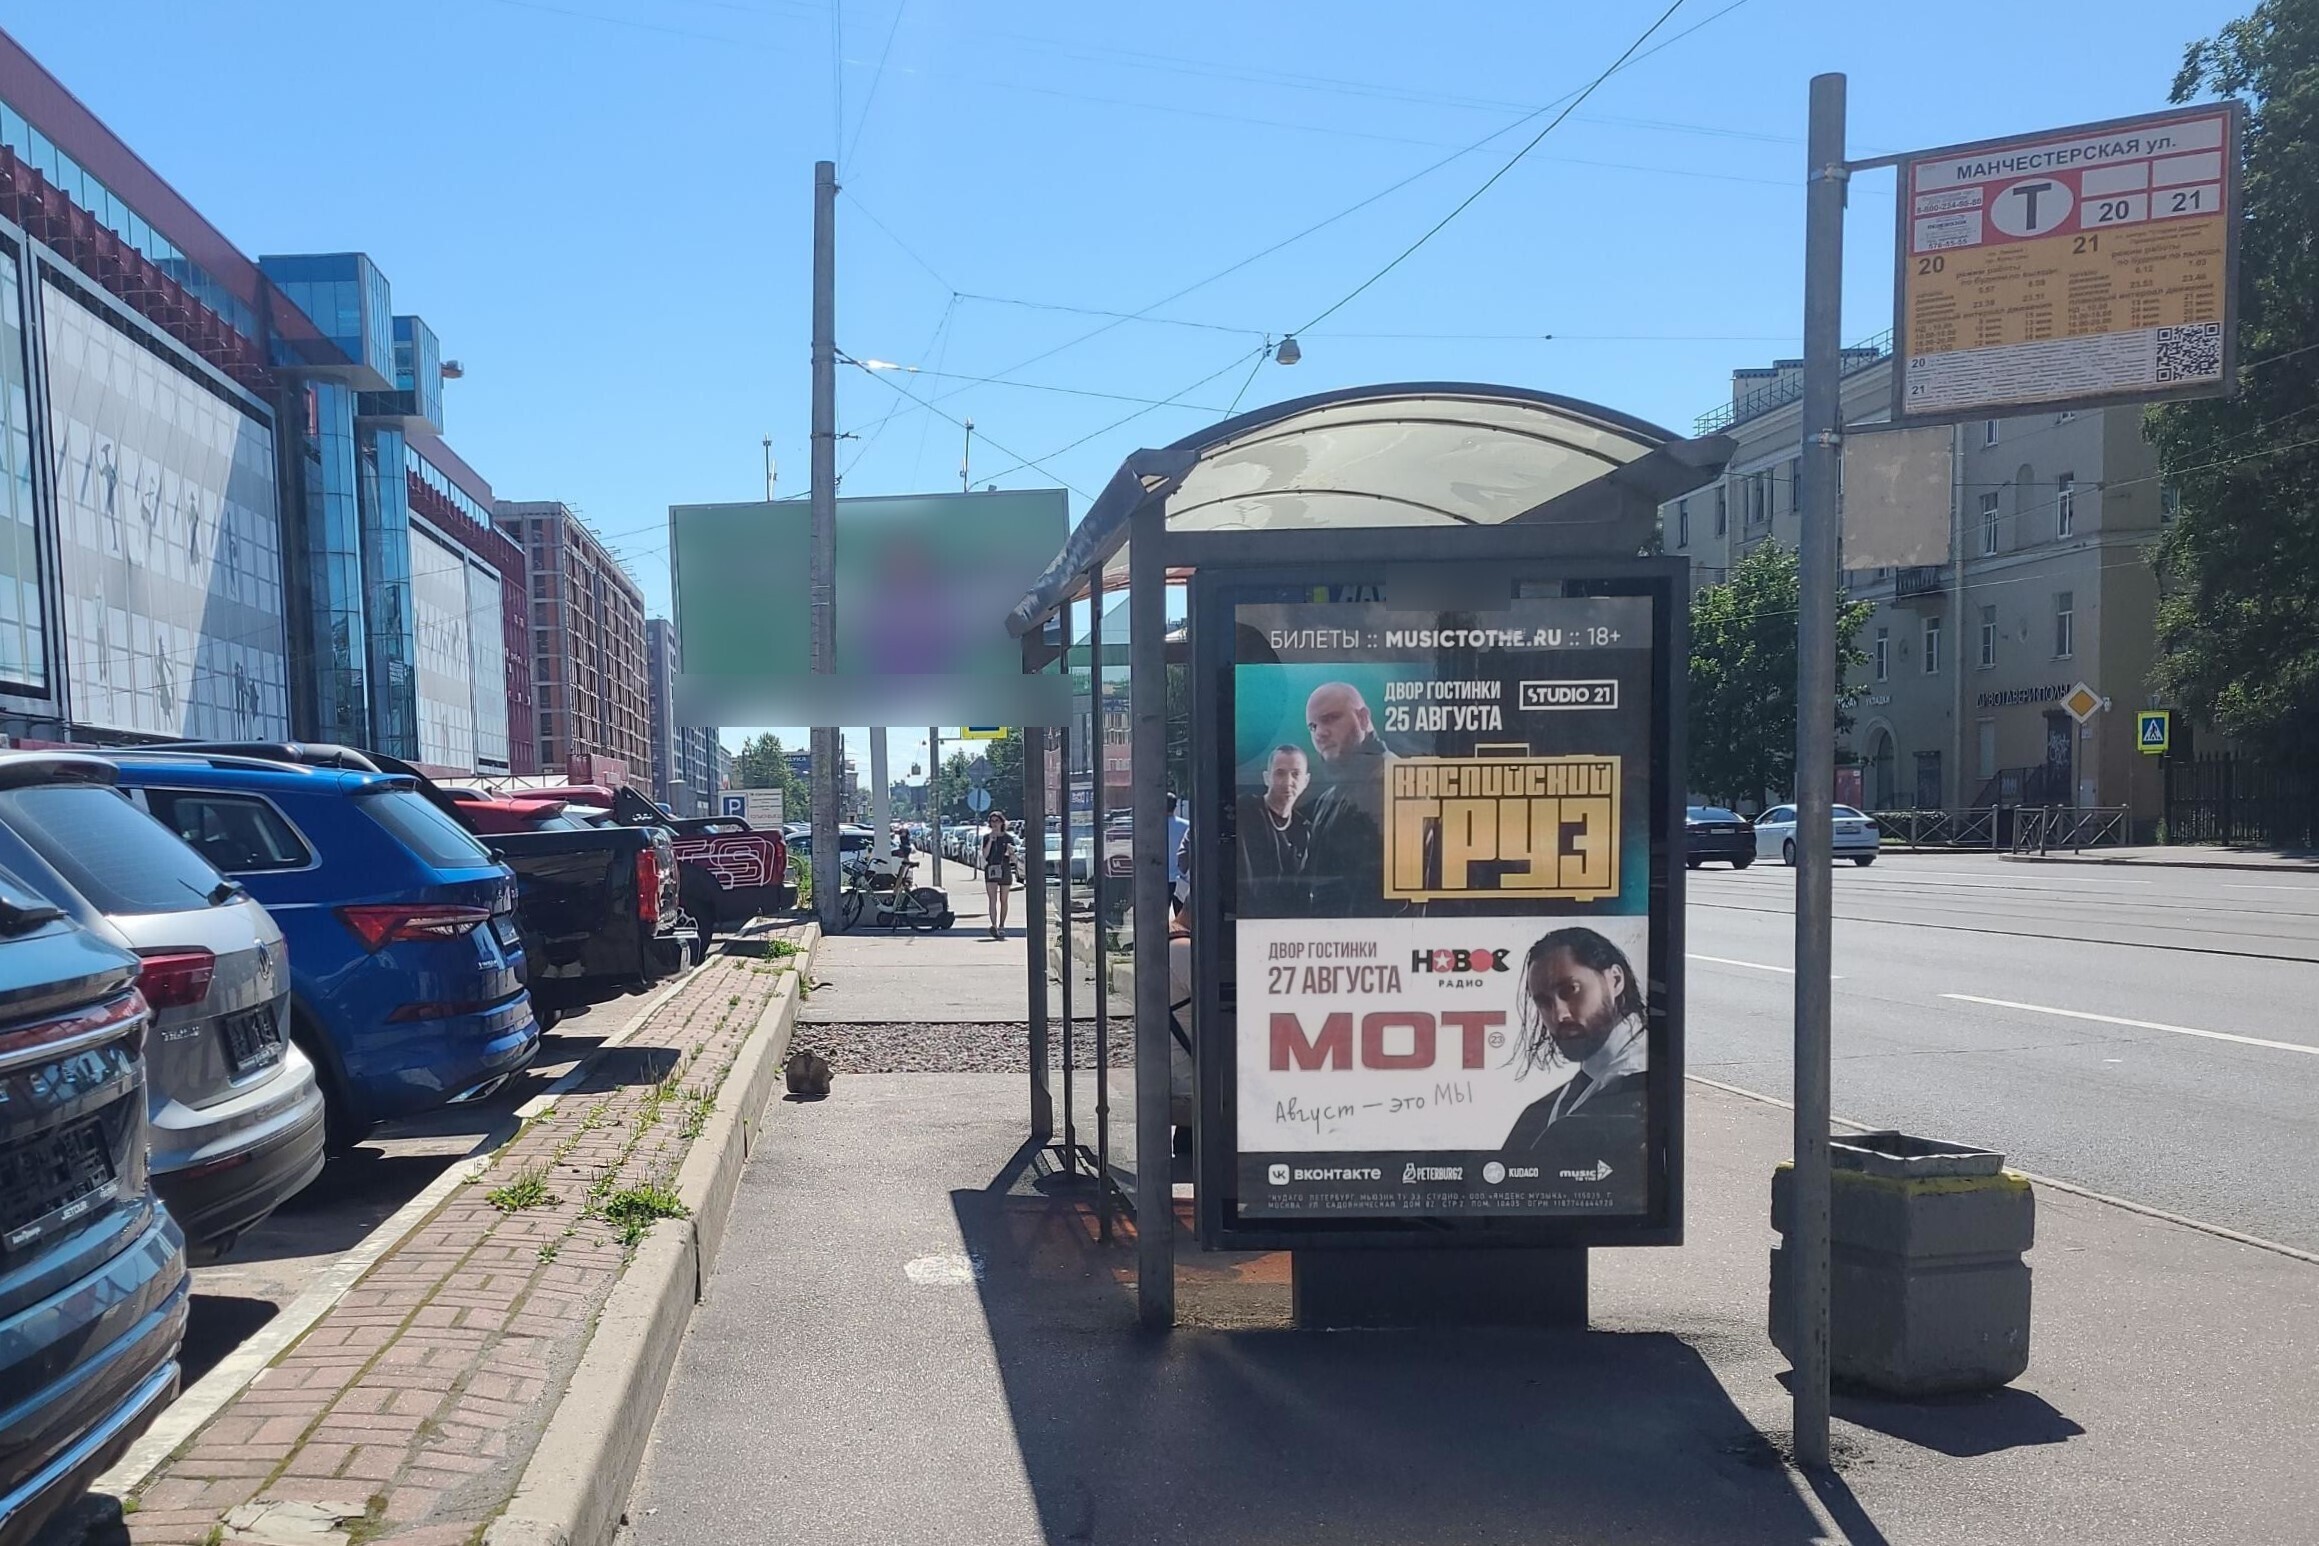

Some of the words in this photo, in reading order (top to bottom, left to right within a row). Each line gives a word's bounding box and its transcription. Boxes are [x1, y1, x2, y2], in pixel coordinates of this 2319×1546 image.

[1956, 140, 2140, 180] МАНЧЕСТЕРСКАЯ
[2146, 137, 2177, 156] ул.
[2013, 182, 2052, 230] Т
[2098, 200, 2130, 223] 20
[2172, 190, 2201, 213] 21
[2072, 234, 2098, 254] 21
[1918, 256, 1944, 276] 20
[1912, 358, 1926, 368] 20
[1912, 386, 1925, 395] 21
[1270, 630, 1360, 650] БИЛЕТЫ
[1385, 629, 1562, 648] MUSICTOTHE.RU
[1586, 627, 1622, 646] 18+
[1384, 681, 1425, 702] ДВОР
[1426, 680, 1501, 701] ГОСТИНКИ
[1527, 687, 1590, 704] STUDIO
[1593, 687, 1611, 702] 21
[1384, 706, 1410, 732] 25
[1415, 704, 1503, 732] АВГУСТА
[728, 799, 741, 816] P
[1394, 798, 1612, 890] ГРУЗ
[1268, 942, 1305, 961] ДВОР
[1308, 942, 1378, 958] ГОСТИНКИ
[1268, 966, 1295, 995] 27
[1302, 964, 1402, 995] АВГУСТА
[1438, 979, 1484, 988] РАДИО
[1269, 1011, 1507, 1072] МОТ
[1275, 1098, 1356, 1135] Август
[1388, 1095, 1426, 1114] это
[1434, 1081, 1473, 1106] МЫ
[1509, 1168, 1539, 1178] KUDAGO
